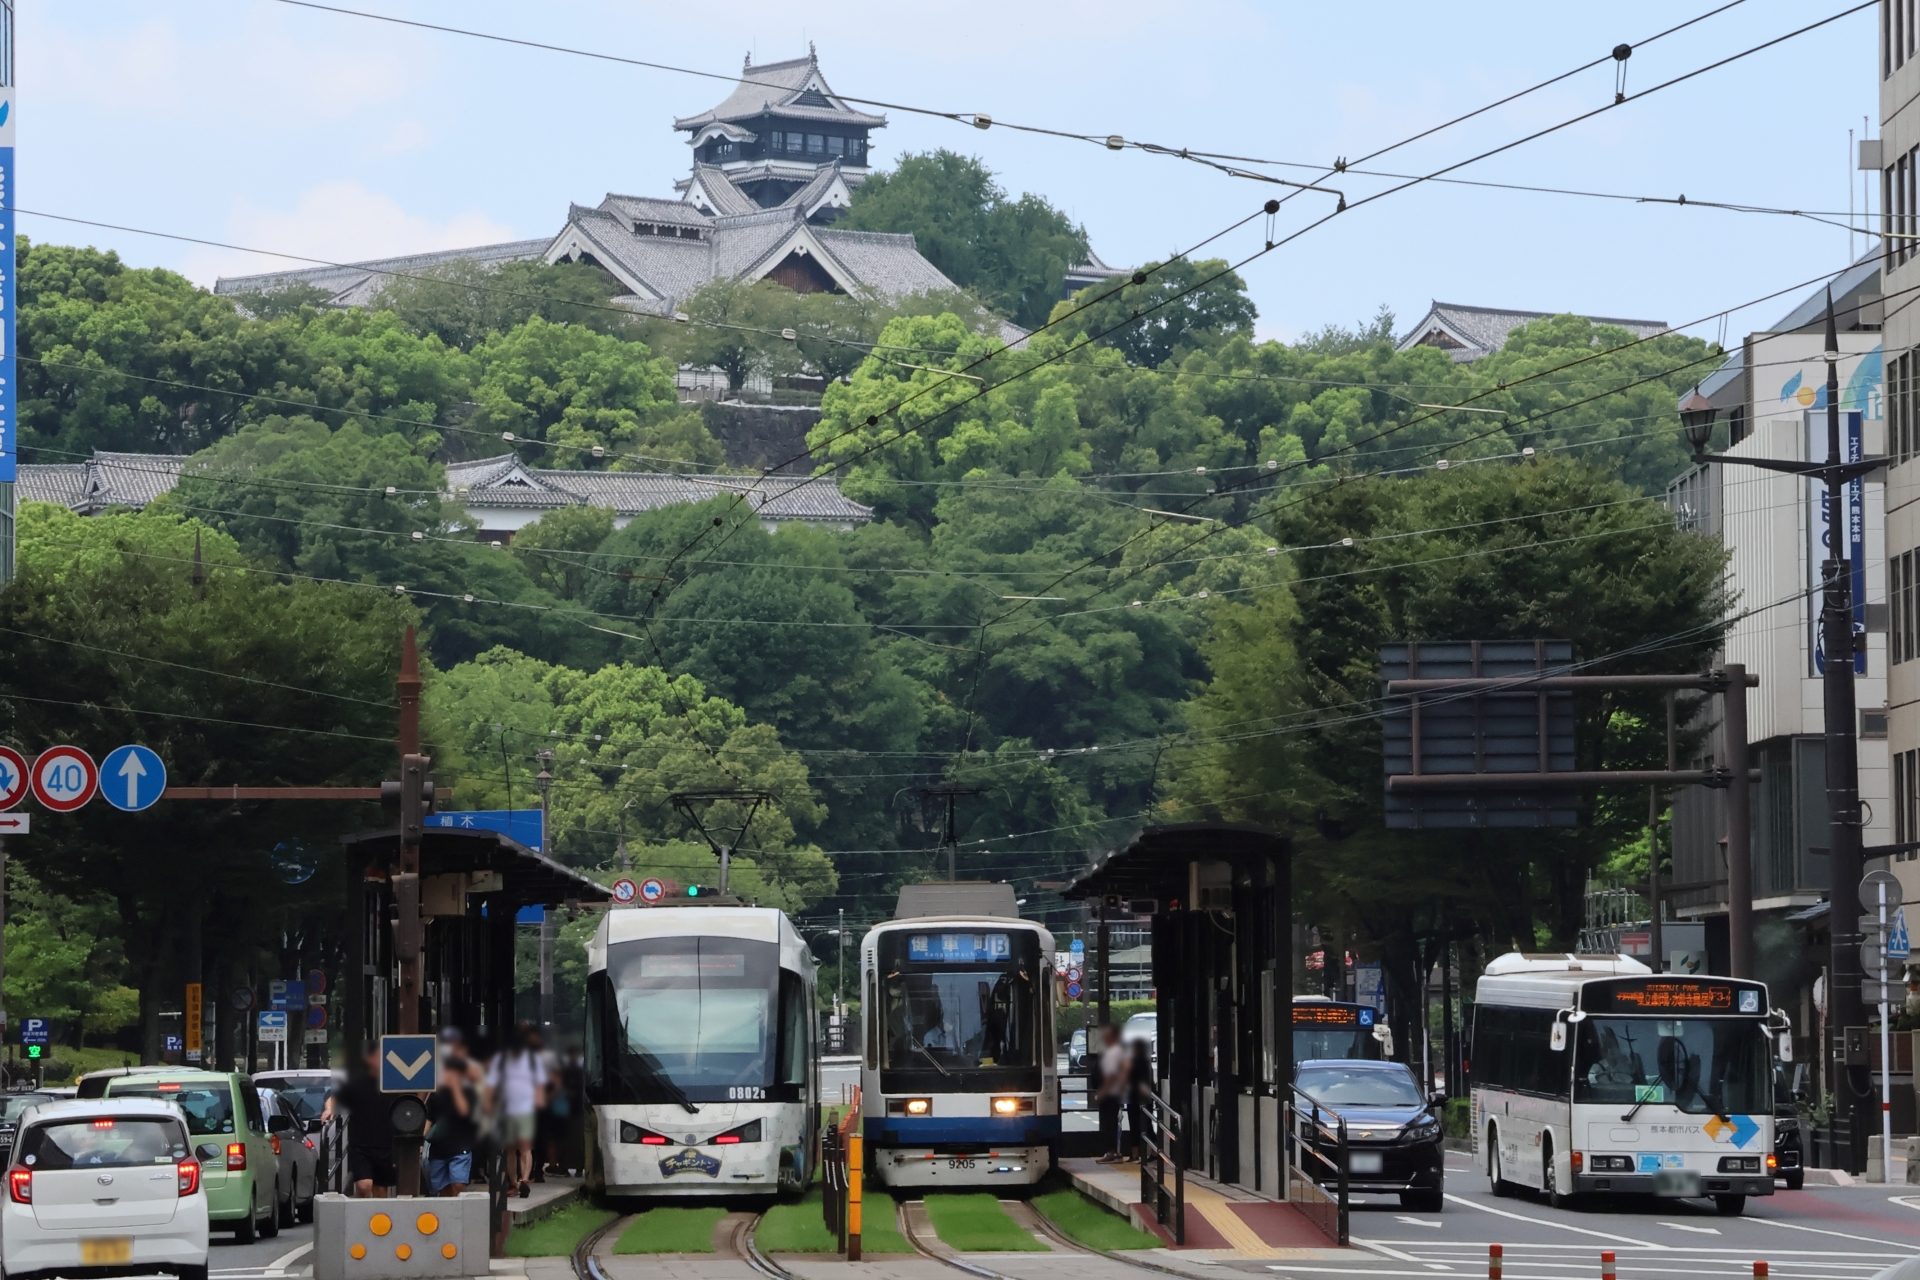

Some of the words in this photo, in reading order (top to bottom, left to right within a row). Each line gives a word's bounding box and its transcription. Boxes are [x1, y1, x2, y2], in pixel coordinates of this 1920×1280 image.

[1851, 506, 1861, 543] 熊本本店
[47, 764, 82, 792] 40
[440, 815, 474, 829] 植木
[911, 935, 989, 952] 健軍町
[994, 937, 1006, 954] B
[28, 1018, 43, 1032] P
[167, 1036, 177, 1046] P
[1650, 1125, 1700, 1134] 熊本都市バス
[665, 1157, 716, 1171] チャギントン
[948, 1159, 976, 1170] 9205
